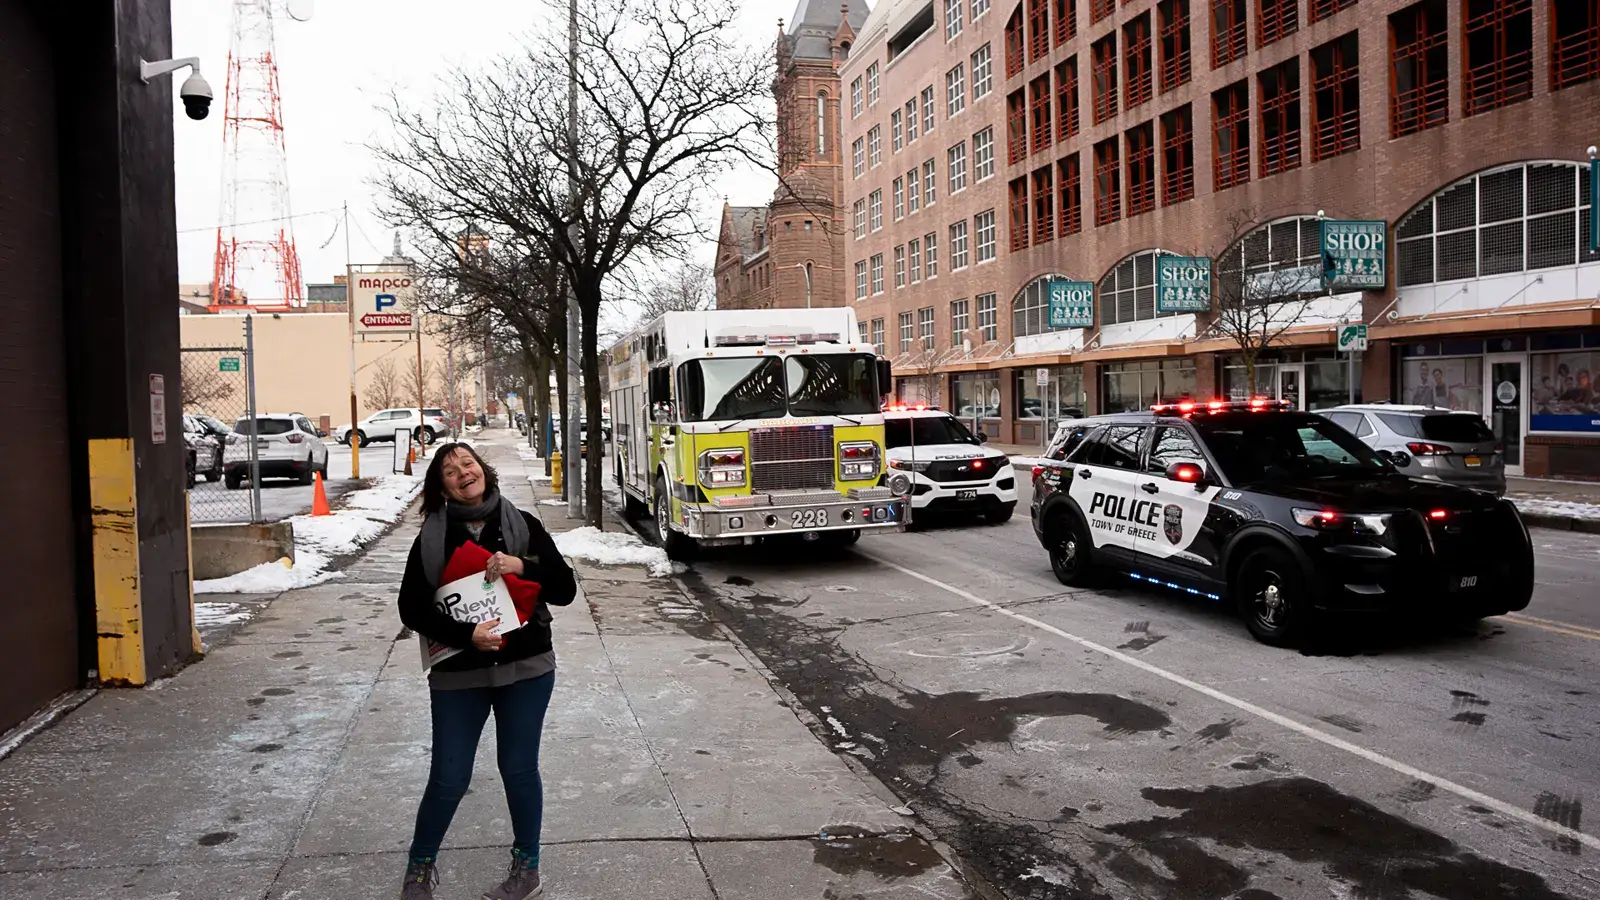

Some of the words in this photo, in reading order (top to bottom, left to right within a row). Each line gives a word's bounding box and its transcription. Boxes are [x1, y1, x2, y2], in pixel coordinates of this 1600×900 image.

[1327, 233, 1383, 250] SHOP
[1163, 267, 1208, 281] SHOP
[375, 294, 397, 312] P
[1052, 290, 1091, 302] SHOP
[364, 315, 411, 324] ENTRANCE
[1223, 490, 1243, 501] 810
[1089, 491, 1163, 527] POLICE
[791, 508, 828, 529] 228
[1091, 519, 1114, 531] TOWN
[1114, 524, 1126, 533] OF
[1127, 526, 1158, 541] GREECE
[1460, 575, 1478, 588] 810
[453, 595, 497, 619] New
